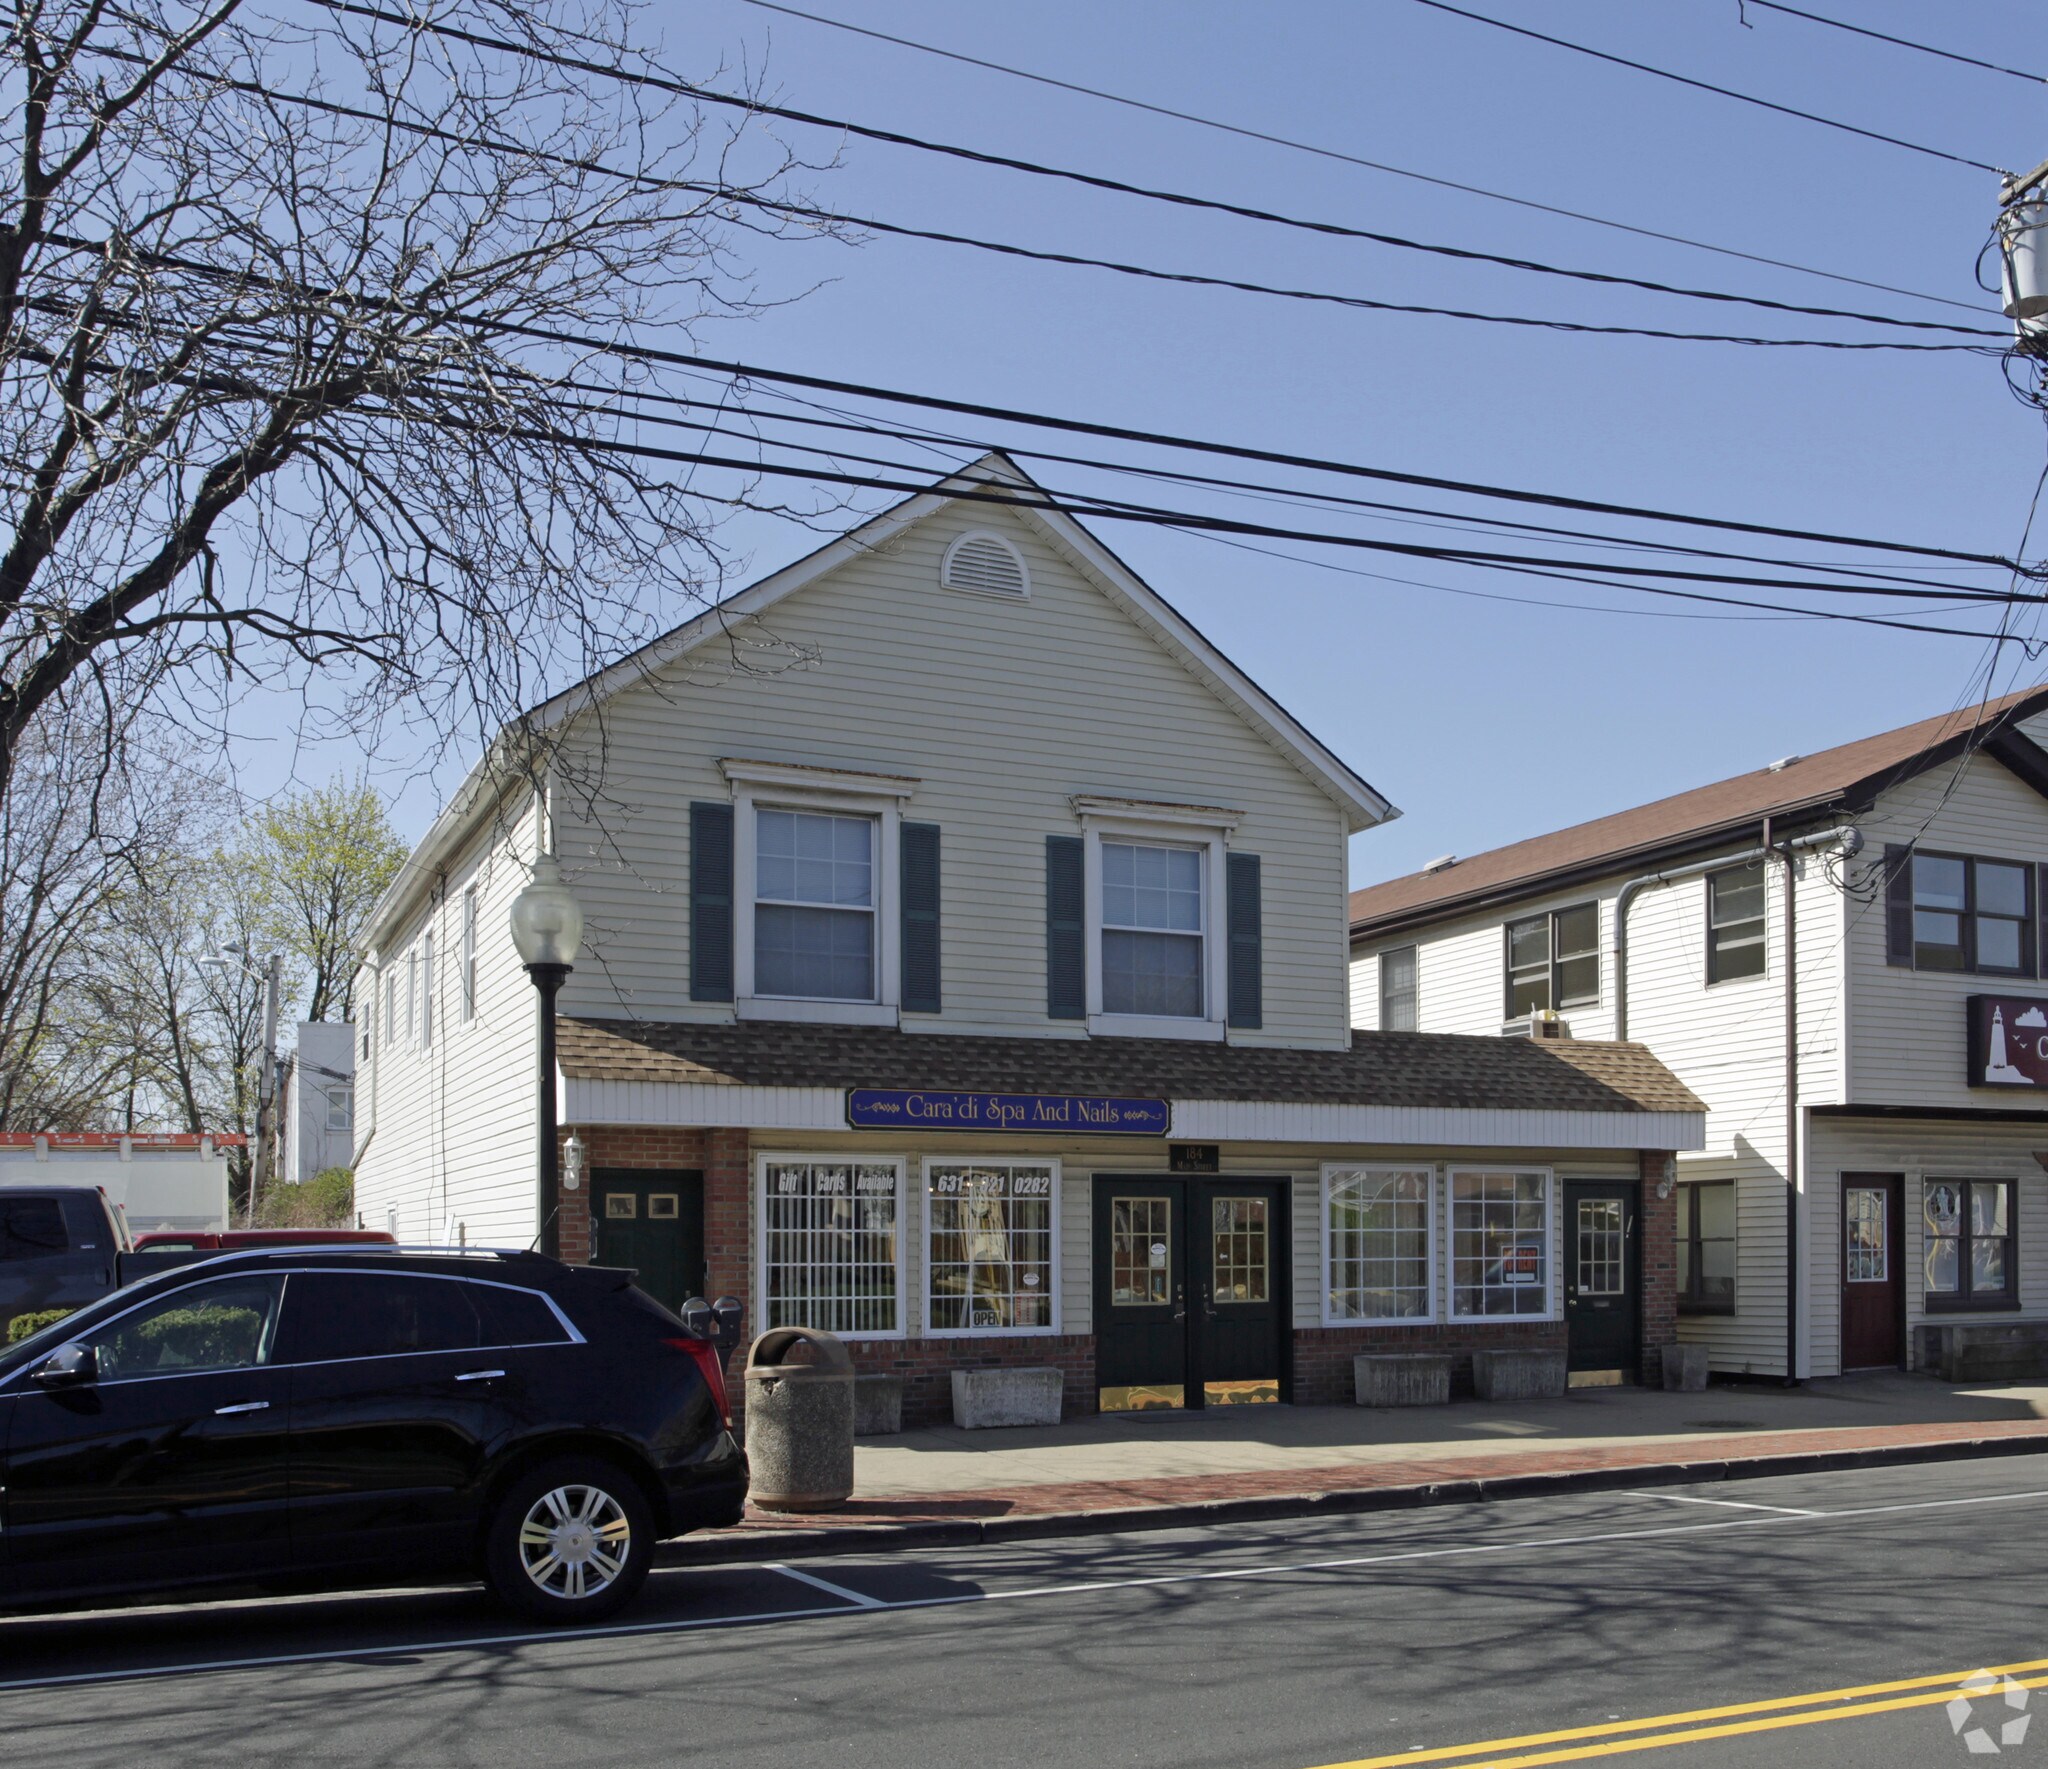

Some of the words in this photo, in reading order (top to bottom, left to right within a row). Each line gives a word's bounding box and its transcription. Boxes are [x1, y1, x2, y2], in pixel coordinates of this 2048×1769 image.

[905, 1094, 979, 1119] Cara'di
[986, 1097, 1026, 1128] Spa
[1032, 1098, 1070, 1122] And
[1077, 1100, 1120, 1123] Nails
[1186, 1147, 1204, 1160] 184
[778, 1172, 798, 1192] Gift
[816, 1172, 846, 1192] Cards
[856, 1174, 895, 1191] Available
[937, 1175, 964, 1193] 631
[1013, 1176, 1050, 1194] 0282
[973, 1311, 1001, 1326] OPEN
